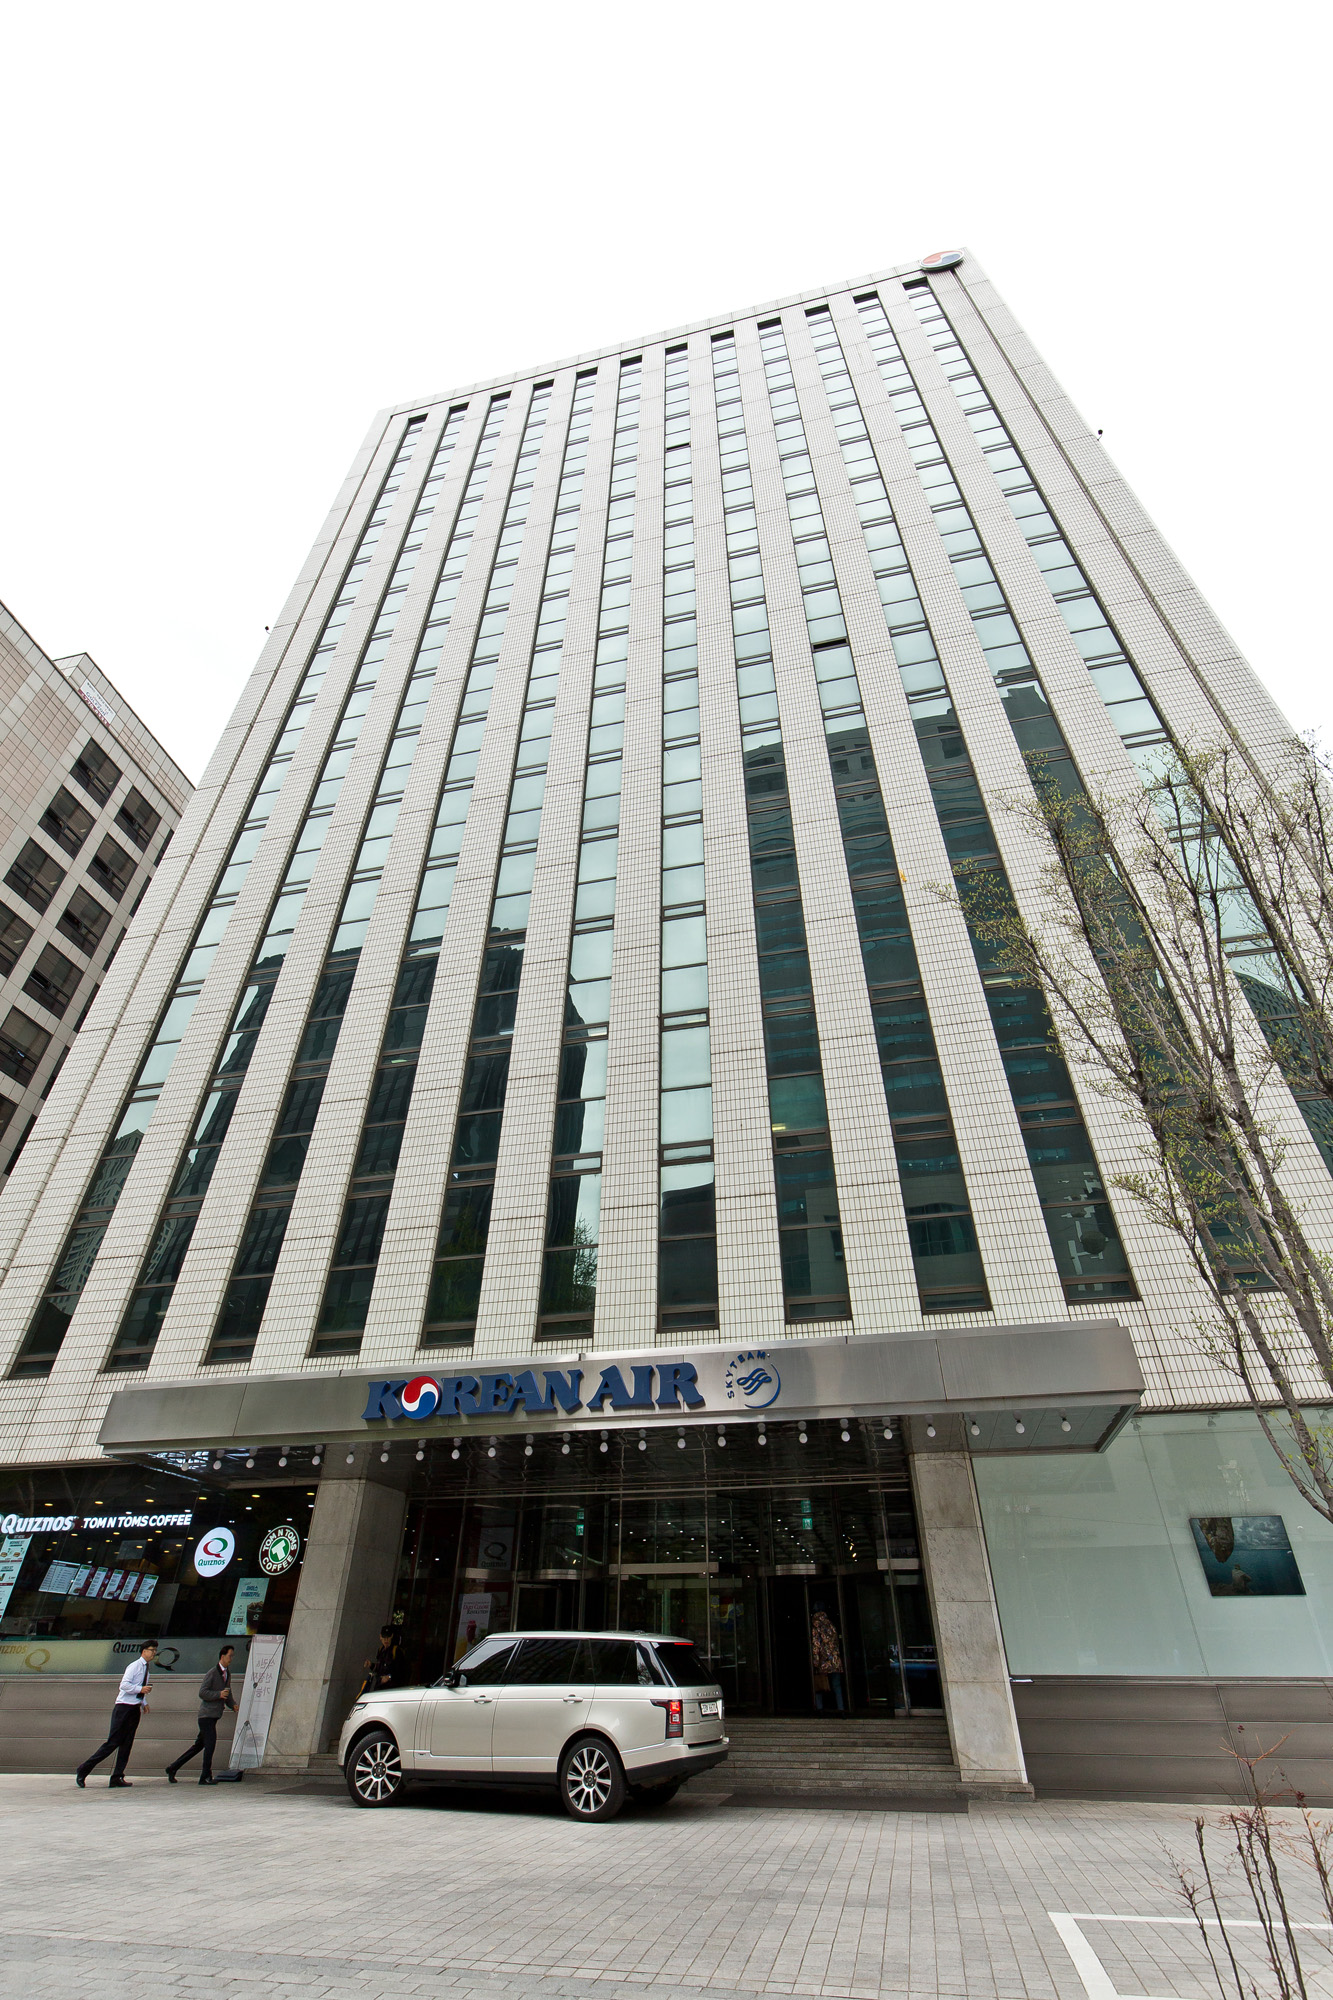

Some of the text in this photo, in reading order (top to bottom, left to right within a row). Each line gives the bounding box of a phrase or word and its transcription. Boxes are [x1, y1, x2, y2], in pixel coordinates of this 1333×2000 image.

[725, 1350, 766, 1399] SKYTEAM
[361, 1362, 707, 1421] KOREAN AIR
[1, 1514, 74, 1534] Quiznos
[83, 1514, 192, 1529] TOM N TOMS COFFEE
[262, 1529, 297, 1552] TOM N TOMS
[198, 1558, 226, 1567] Quiznos
[262, 1554, 294, 1572] COFFEE
[113, 1641, 142, 1654] Quizn
